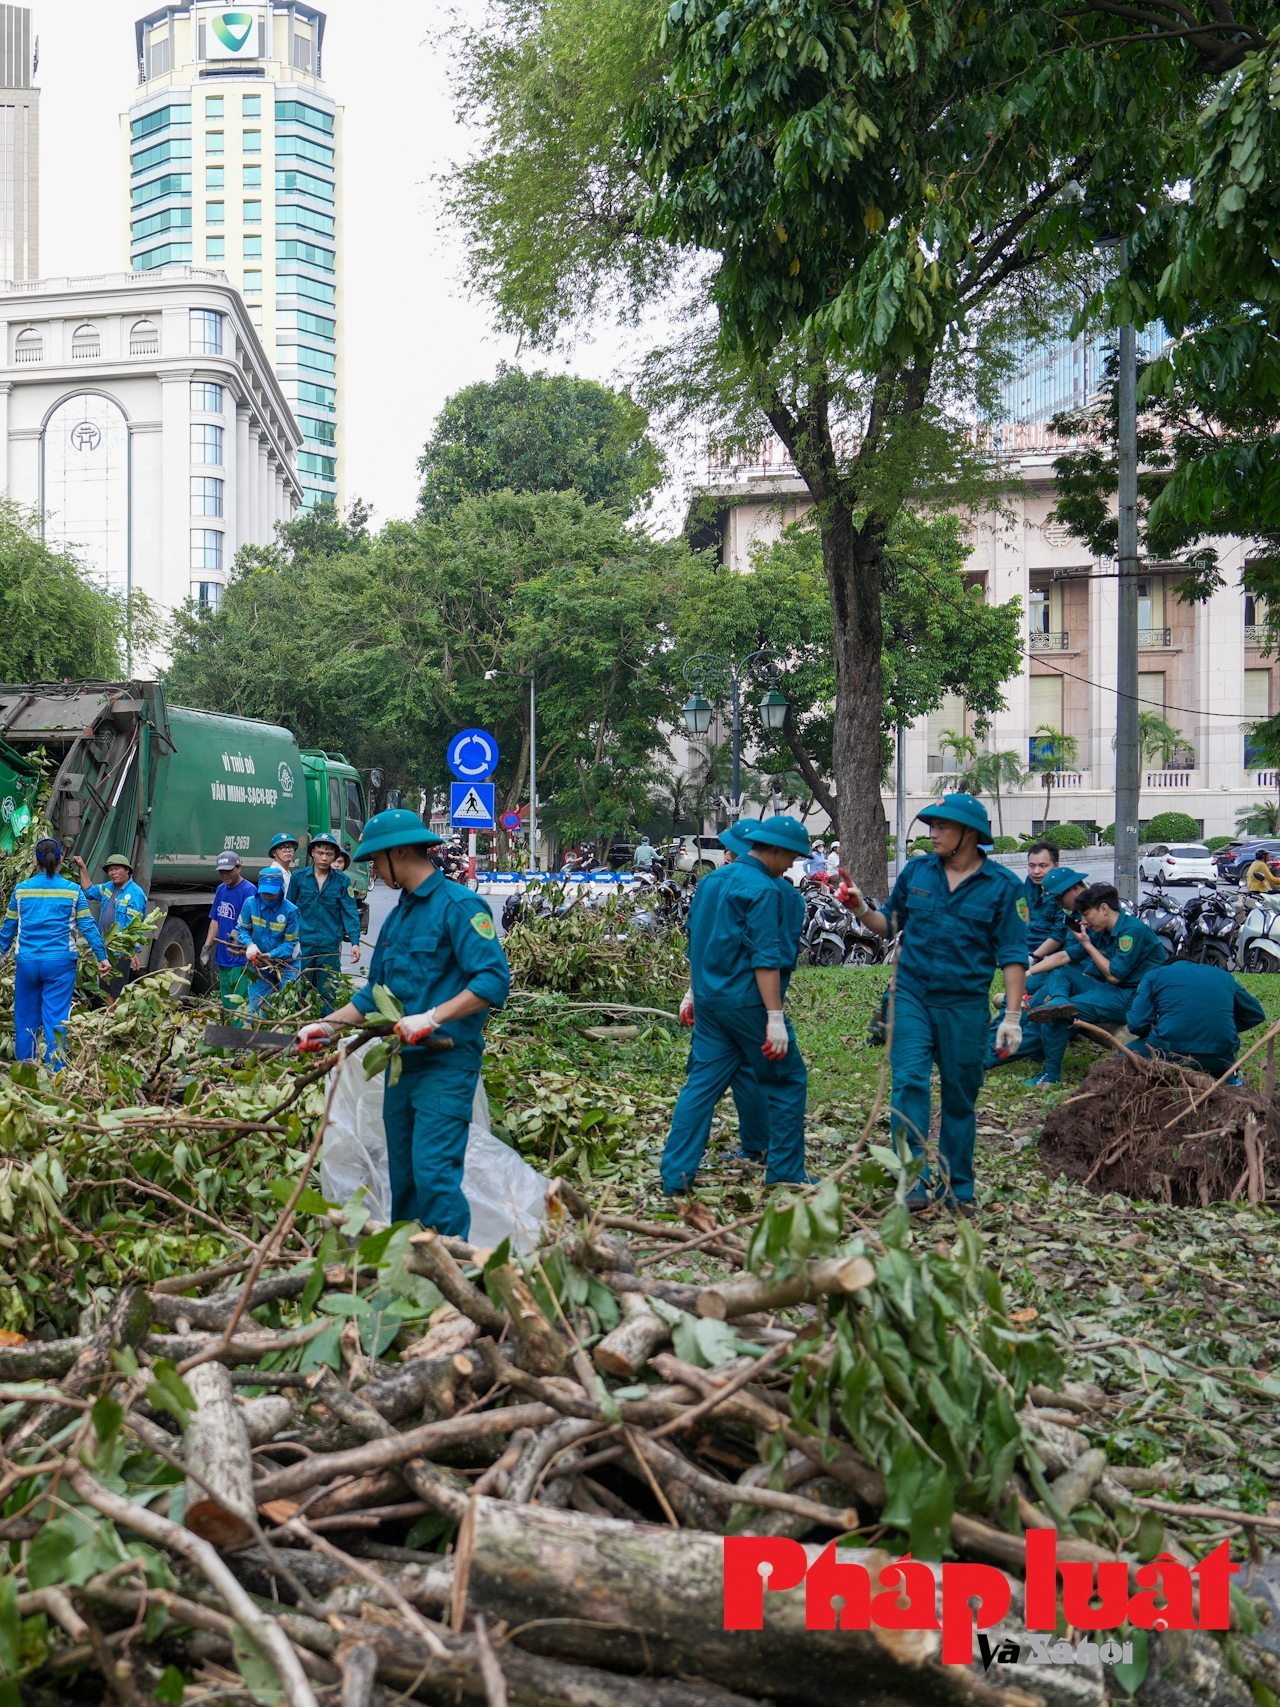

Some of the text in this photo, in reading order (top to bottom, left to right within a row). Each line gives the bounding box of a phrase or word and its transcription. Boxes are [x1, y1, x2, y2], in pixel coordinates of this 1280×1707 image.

[221, 752, 231, 772] VÌ
[230, 752, 245, 774] THỦ
[211, 780, 226, 801] VĂN
